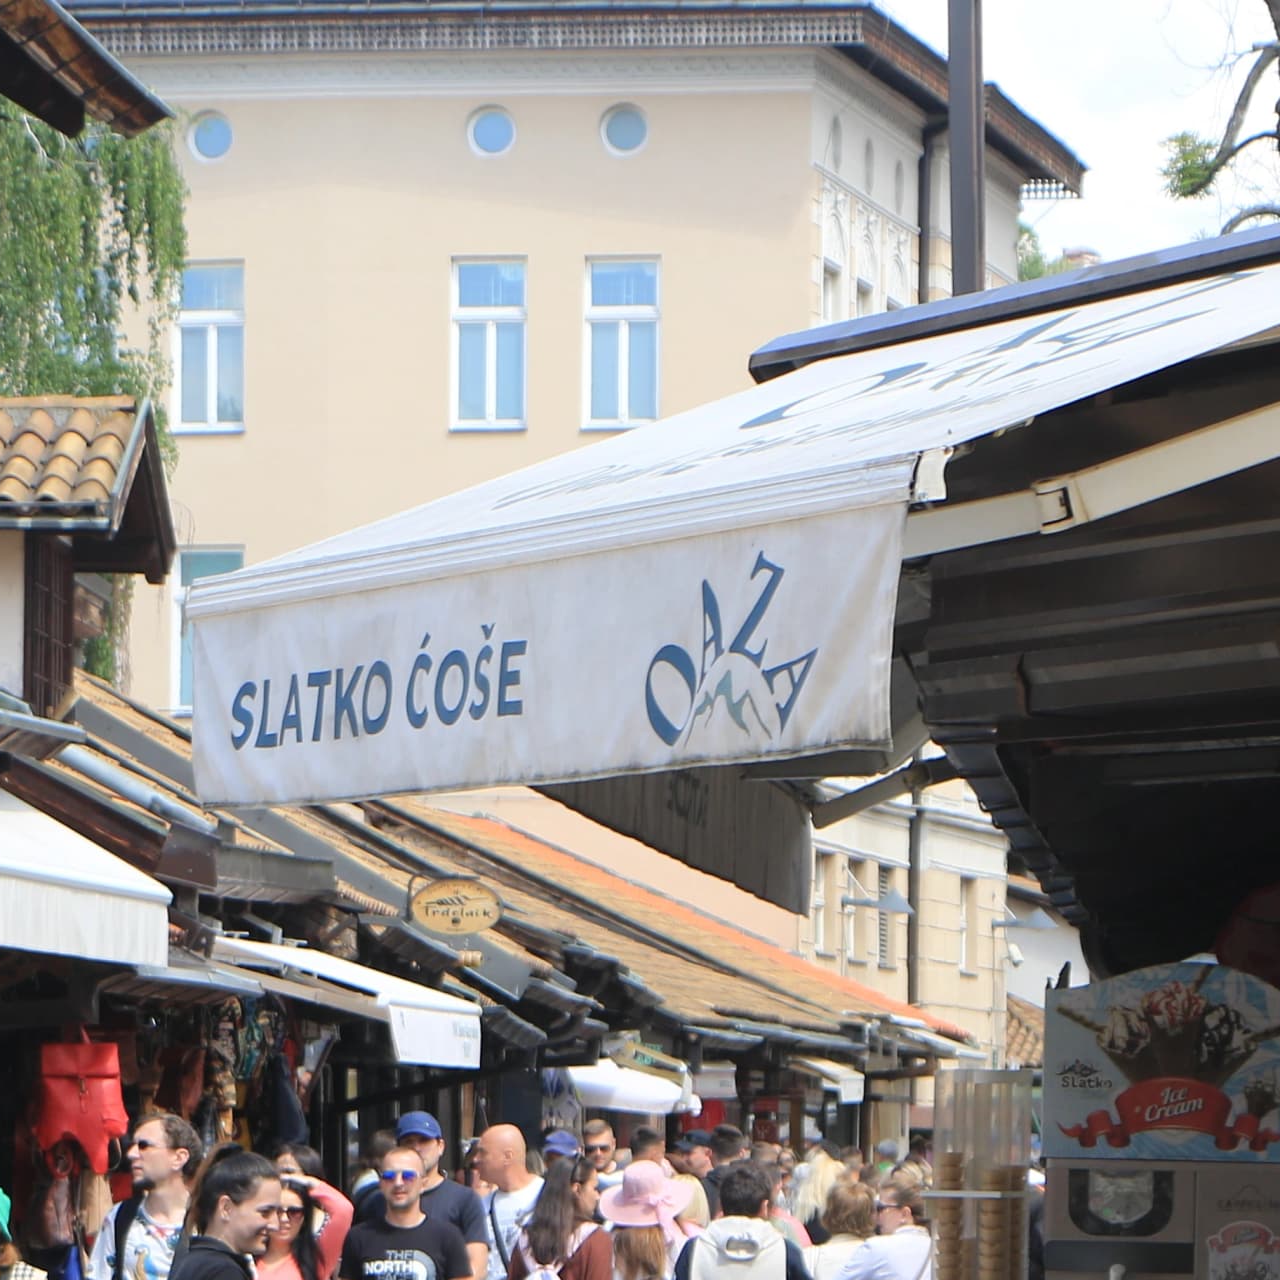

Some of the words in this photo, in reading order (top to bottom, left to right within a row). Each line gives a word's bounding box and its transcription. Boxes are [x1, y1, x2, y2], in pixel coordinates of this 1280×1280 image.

[645, 549, 819, 748] OAZA
[231, 660, 393, 751] SLATKO
[405, 623, 529, 729] ĆOŠE
[1061, 1075, 1113, 1089] Slatko
[1160, 1087, 1188, 1105] Ice
[1144, 1097, 1203, 1123] Cream
[385, 1250, 414, 1261] THE
[363, 1260, 414, 1276] NORTH
